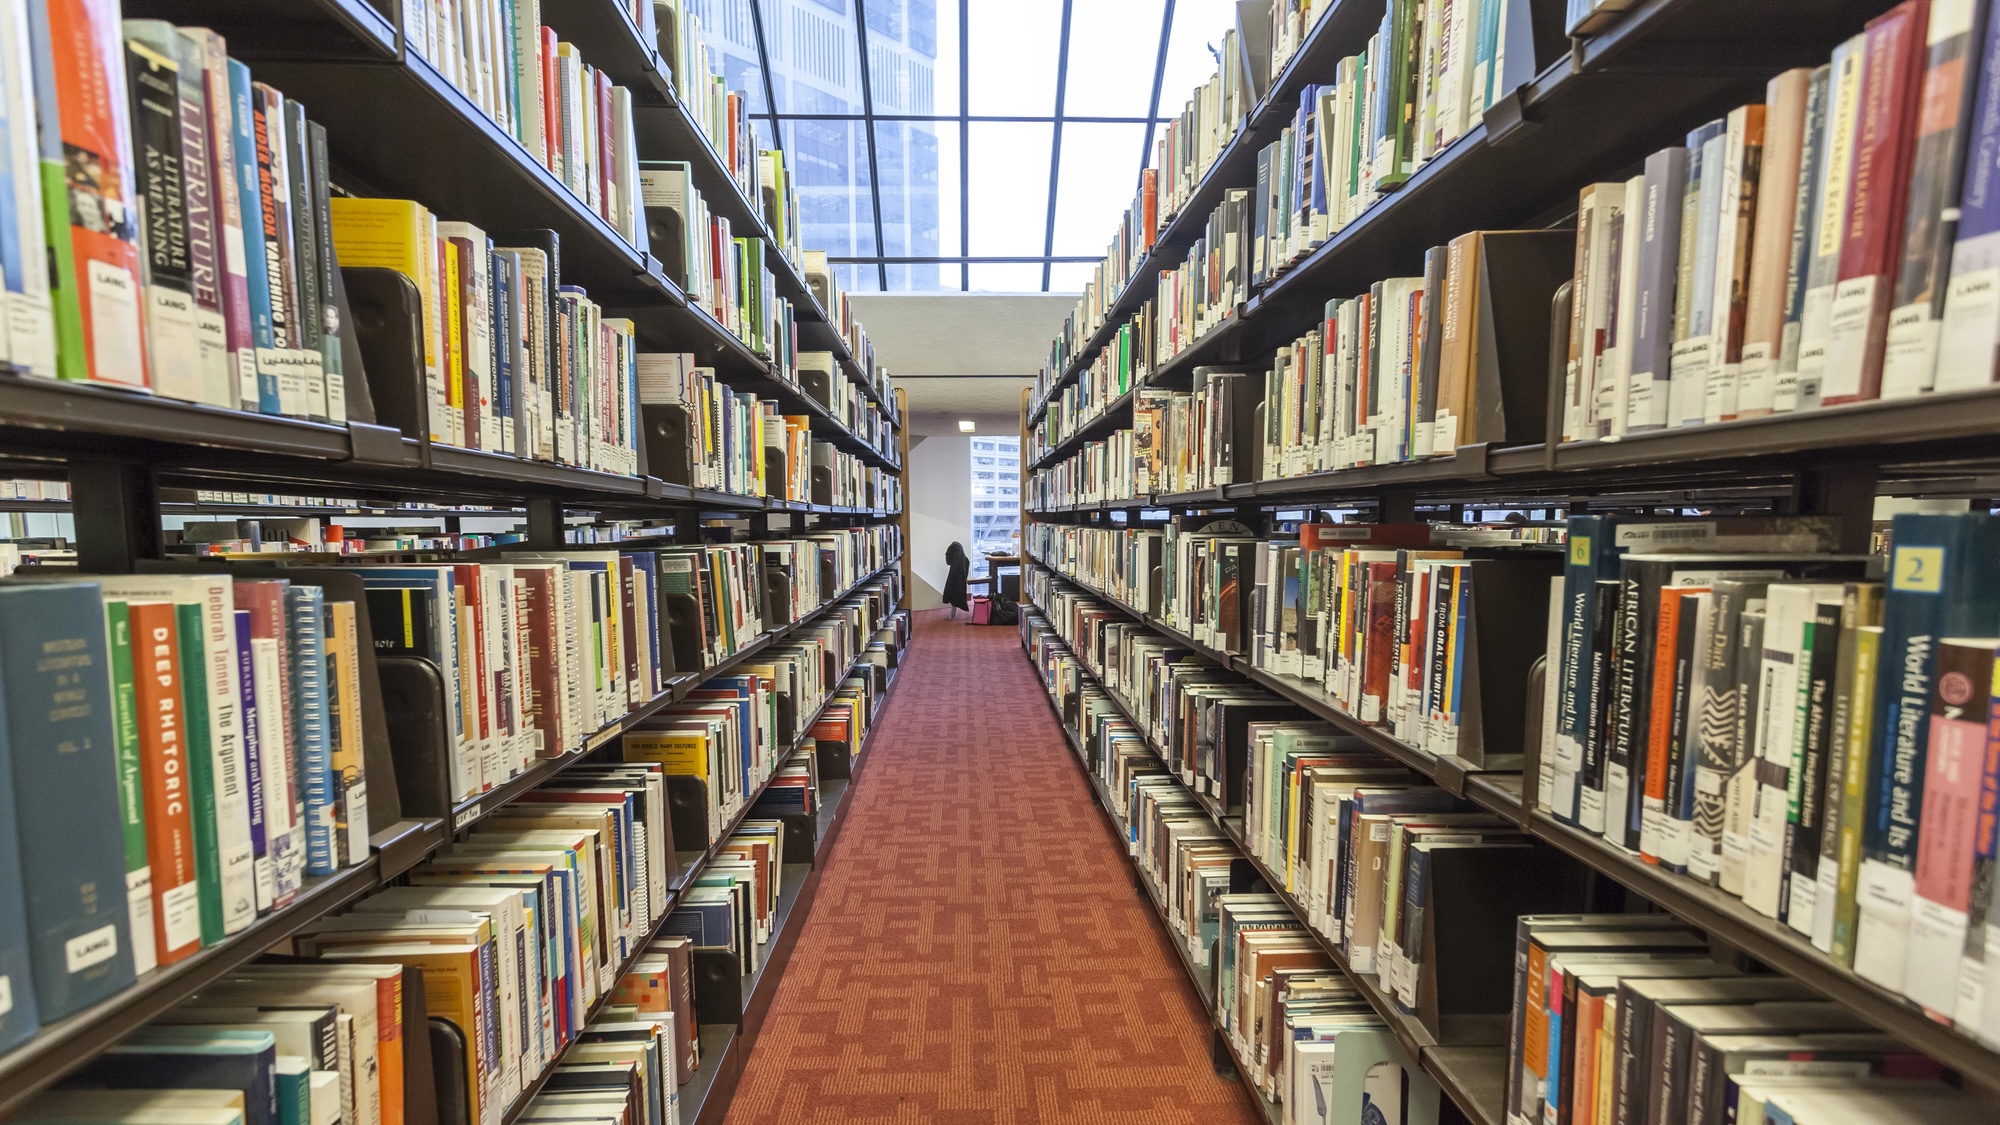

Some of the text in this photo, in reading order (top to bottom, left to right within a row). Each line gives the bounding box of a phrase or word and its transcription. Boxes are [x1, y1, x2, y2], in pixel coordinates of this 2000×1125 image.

[143, 142, 170, 267] AS MEANING
[161, 153, 188, 271] LITERATURE
[182, 98, 215, 307] LITERATURE
[254, 108, 285, 325] ANDER MONSON VANISHING
[1645, 183, 1656, 242] HEROINES
[1821, 187, 1839, 252] READER
[1849, 143, 1873, 239] LITERATURE
[487, 272, 493, 287] TO
[1444, 244, 1457, 340] JEWISH CANON
[1452, 242, 1462, 284] ARGUING
[1956, 282, 1992, 297] LANG
[158, 297, 188, 312] LANG
[304, 261, 316, 350] AND MORALS
[1367, 294, 1378, 351] PUNS
[1449, 299, 1458, 339] MODERN
[1840, 287, 1866, 300] LANG
[1890, 314, 1920, 329] LANG
[1576, 545, 1584, 560] 6
[1906, 556, 1924, 582] 2
[347, 616, 356, 640] The
[547, 575, 558, 669] CREATIVITY RULES!
[1395, 583, 1403, 636] SCHOMBURG
[1616, 593, 1624, 642] ANTHOLOGY
[152, 626, 173, 688] DEEP
[348, 643, 360, 702] Midnight
[447, 590, 460, 704] 20 Master Plots
[462, 649, 470, 692] Writing
[1435, 659, 1442, 671] TO
[1436, 629, 1444, 657] ORAL
[1564, 592, 1586, 731] World Literature and Its
[1616, 579, 1639, 758] AFRICAN LITERATURE
[1711, 632, 1728, 672] Dark
[1902, 632, 1928, 694] World
[118, 681, 136, 747] Essentials
[207, 586, 240, 798] Deborah Tannen The Argument
[276, 640, 295, 785] Rhetorical Narratology
[1590, 650, 1602, 728] Multiculturalism
[241, 649, 263, 827] EUBANKS Metaphor and Writing
[267, 682, 281, 803] LINGUISTIC CRITICISM
[353, 707, 363, 756] Disease
[1587, 739, 1596, 767] Israel
[1734, 682, 1747, 769] BLACK WRITERS
[1800, 678, 1824, 829] The African Imagination
[1893, 694, 1921, 787] Literature
[157, 696, 183, 818] RHETORIC
[1824, 693, 1848, 858] LITERATURE OF AFRICA
[123, 760, 140, 827] Argument
[1890, 784, 1913, 825] and
[1888, 823, 1910, 851] Its
[482, 943, 494, 1031] Writer's Market
[528, 931, 536, 988] WRITING
[475, 1010, 484, 1071] AUTHOR'S
[520, 999, 528, 1051] RETIREMENT
[1622, 1007, 1634, 1038] history
[1662, 1035, 1677, 1071] history
[477, 1066, 486, 1116] TOOLKIT
